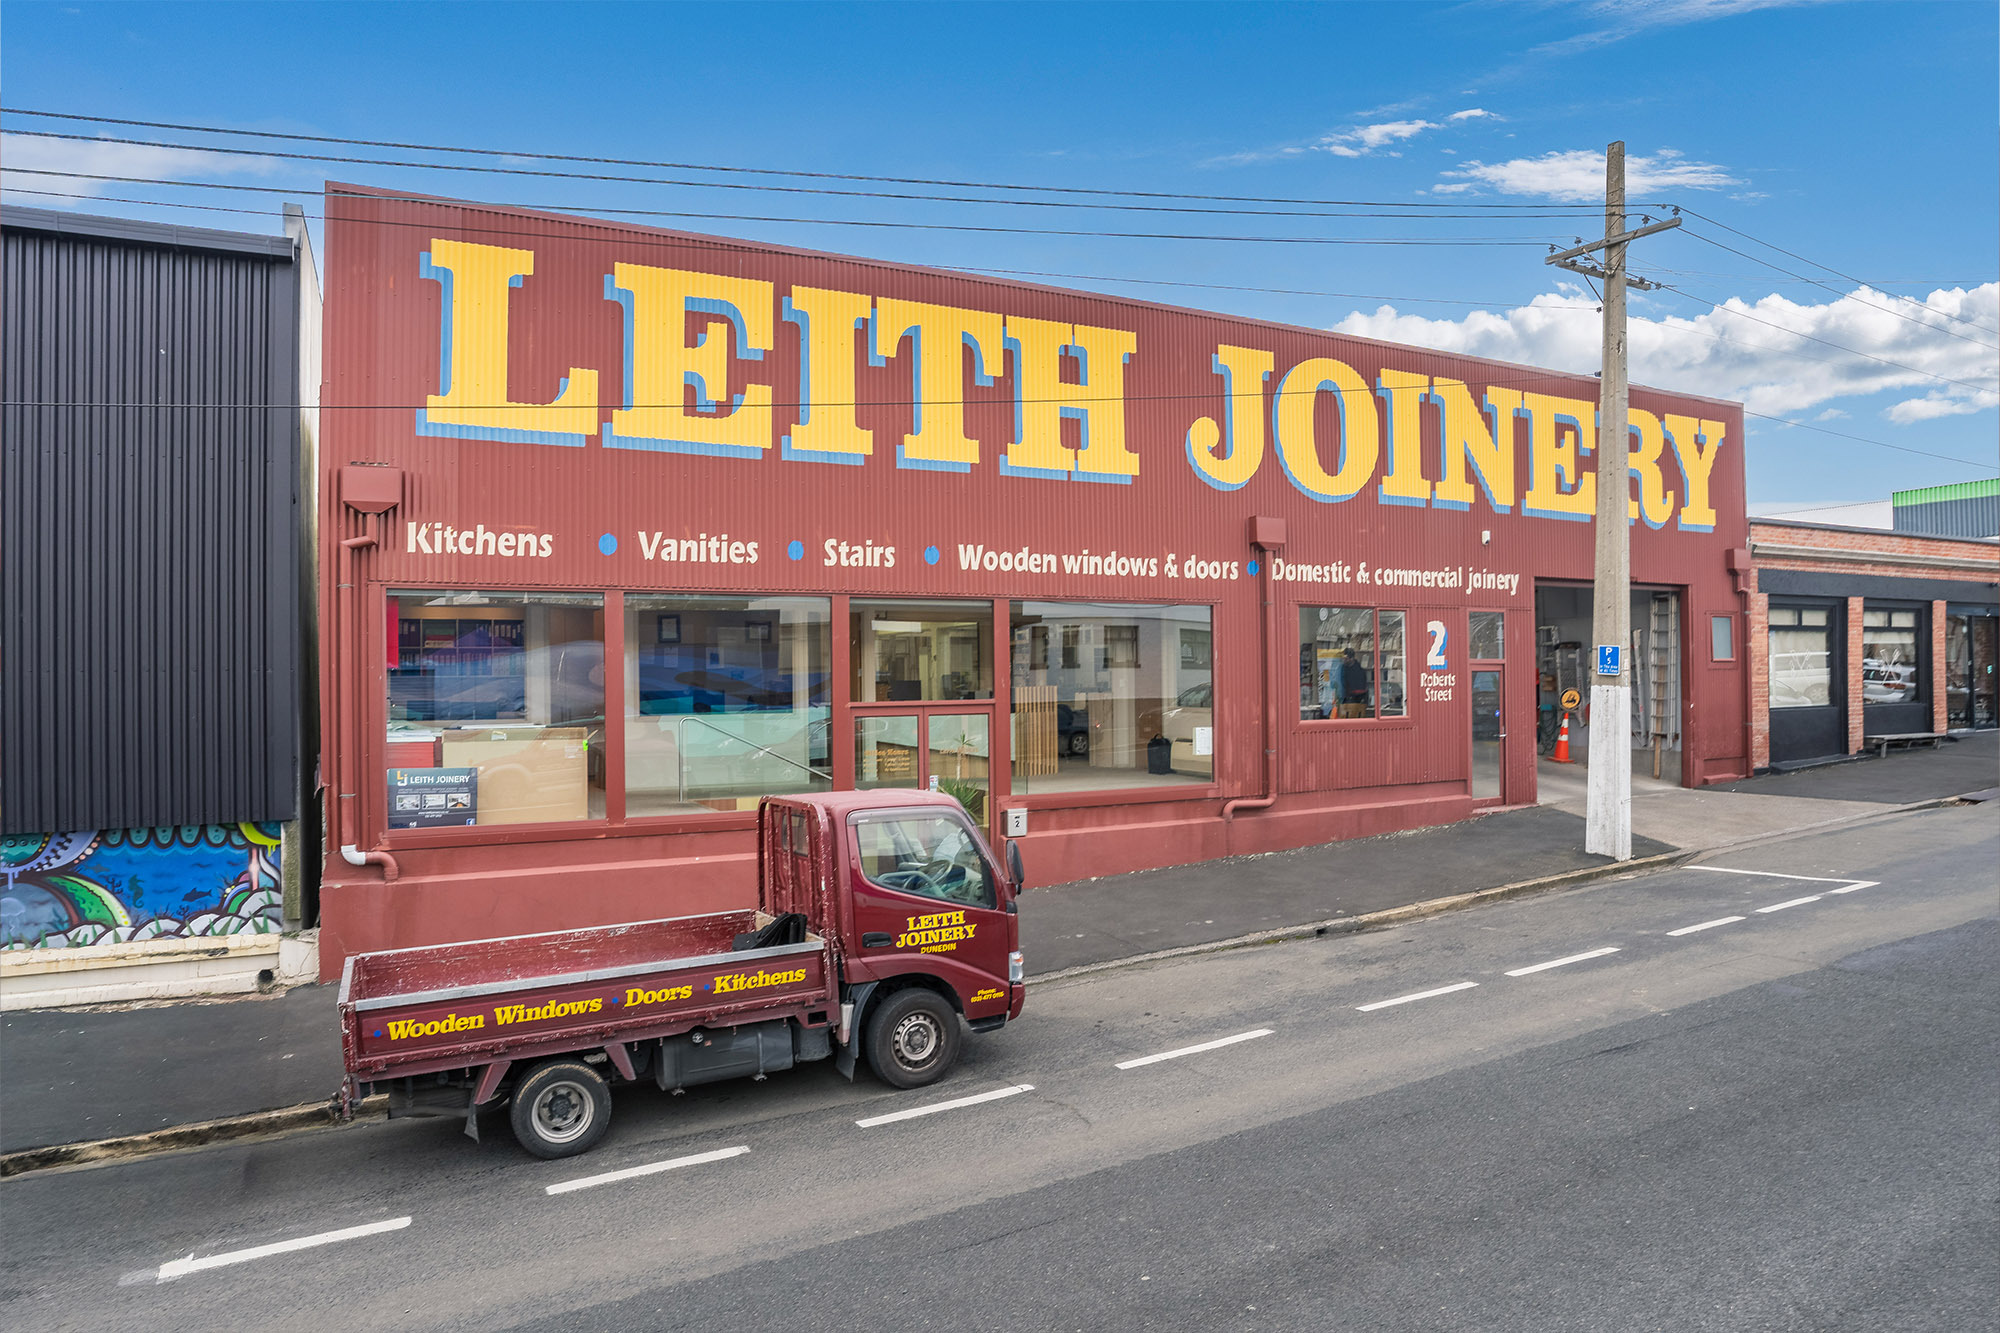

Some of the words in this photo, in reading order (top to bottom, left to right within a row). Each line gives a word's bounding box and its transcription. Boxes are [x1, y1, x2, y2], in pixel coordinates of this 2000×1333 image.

[416, 237, 1140, 485] LEITH
[1185, 344, 1726, 533] JOINERY
[406, 520, 553, 559] Kitchens
[637, 530, 759, 564] Vanities
[823, 538, 896, 568] Stairs
[957, 544, 1058, 575] Wooden
[1061, 549, 1158, 577] windows
[1164, 552, 1179, 578] &
[1183, 554, 1239, 580] doors
[1271, 557, 1351, 584] Domestic
[1356, 561, 1370, 585] &
[1374, 566, 1463, 588] commercial
[1465, 567, 1520, 596] joinery
[1426, 620, 1448, 670] 2
[1605, 647, 1613, 656] P
[1420, 672, 1456, 688] Roberts
[1424, 687, 1453, 702] Street
[410, 776, 434, 784] LEITH
[436, 775, 471, 784] JOINERY
[1014, 820, 1020, 828] 2
[906, 910, 966, 931] LEITH
[895, 923, 978, 948] JOINERY
[920, 942, 957, 954] DUNEDIN
[386, 1013, 486, 1041] Wooden
[493, 997, 604, 1027] Windows
[623, 984, 693, 1008] Doors
[712, 967, 807, 995] Kitchens
